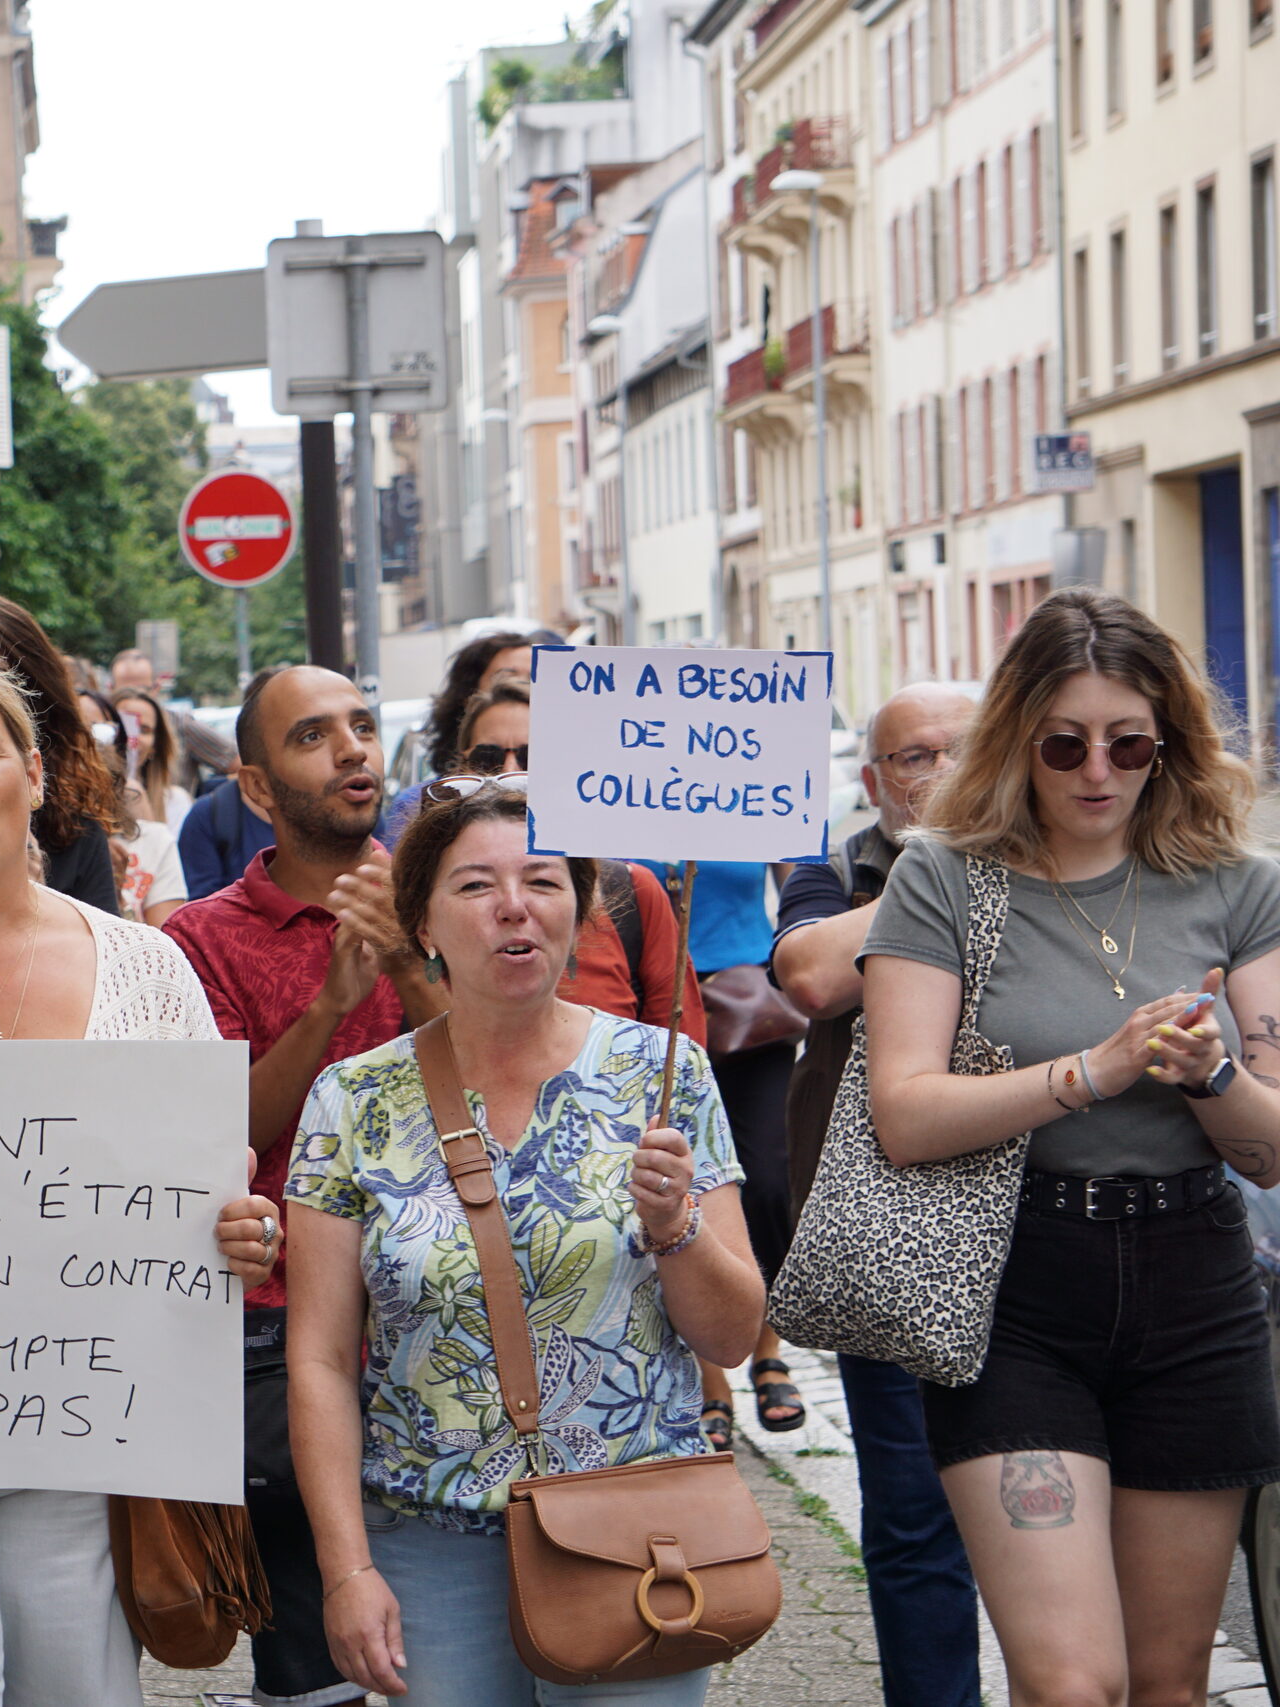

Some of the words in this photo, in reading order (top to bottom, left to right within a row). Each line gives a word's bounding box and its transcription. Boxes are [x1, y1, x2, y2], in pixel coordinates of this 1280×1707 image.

[569, 660, 616, 696] ON
[635, 663, 663, 698] A
[620, 719, 666, 749] DE
[687, 721, 763, 761] NOS
[60, 1254, 239, 1304] CONTRAT
